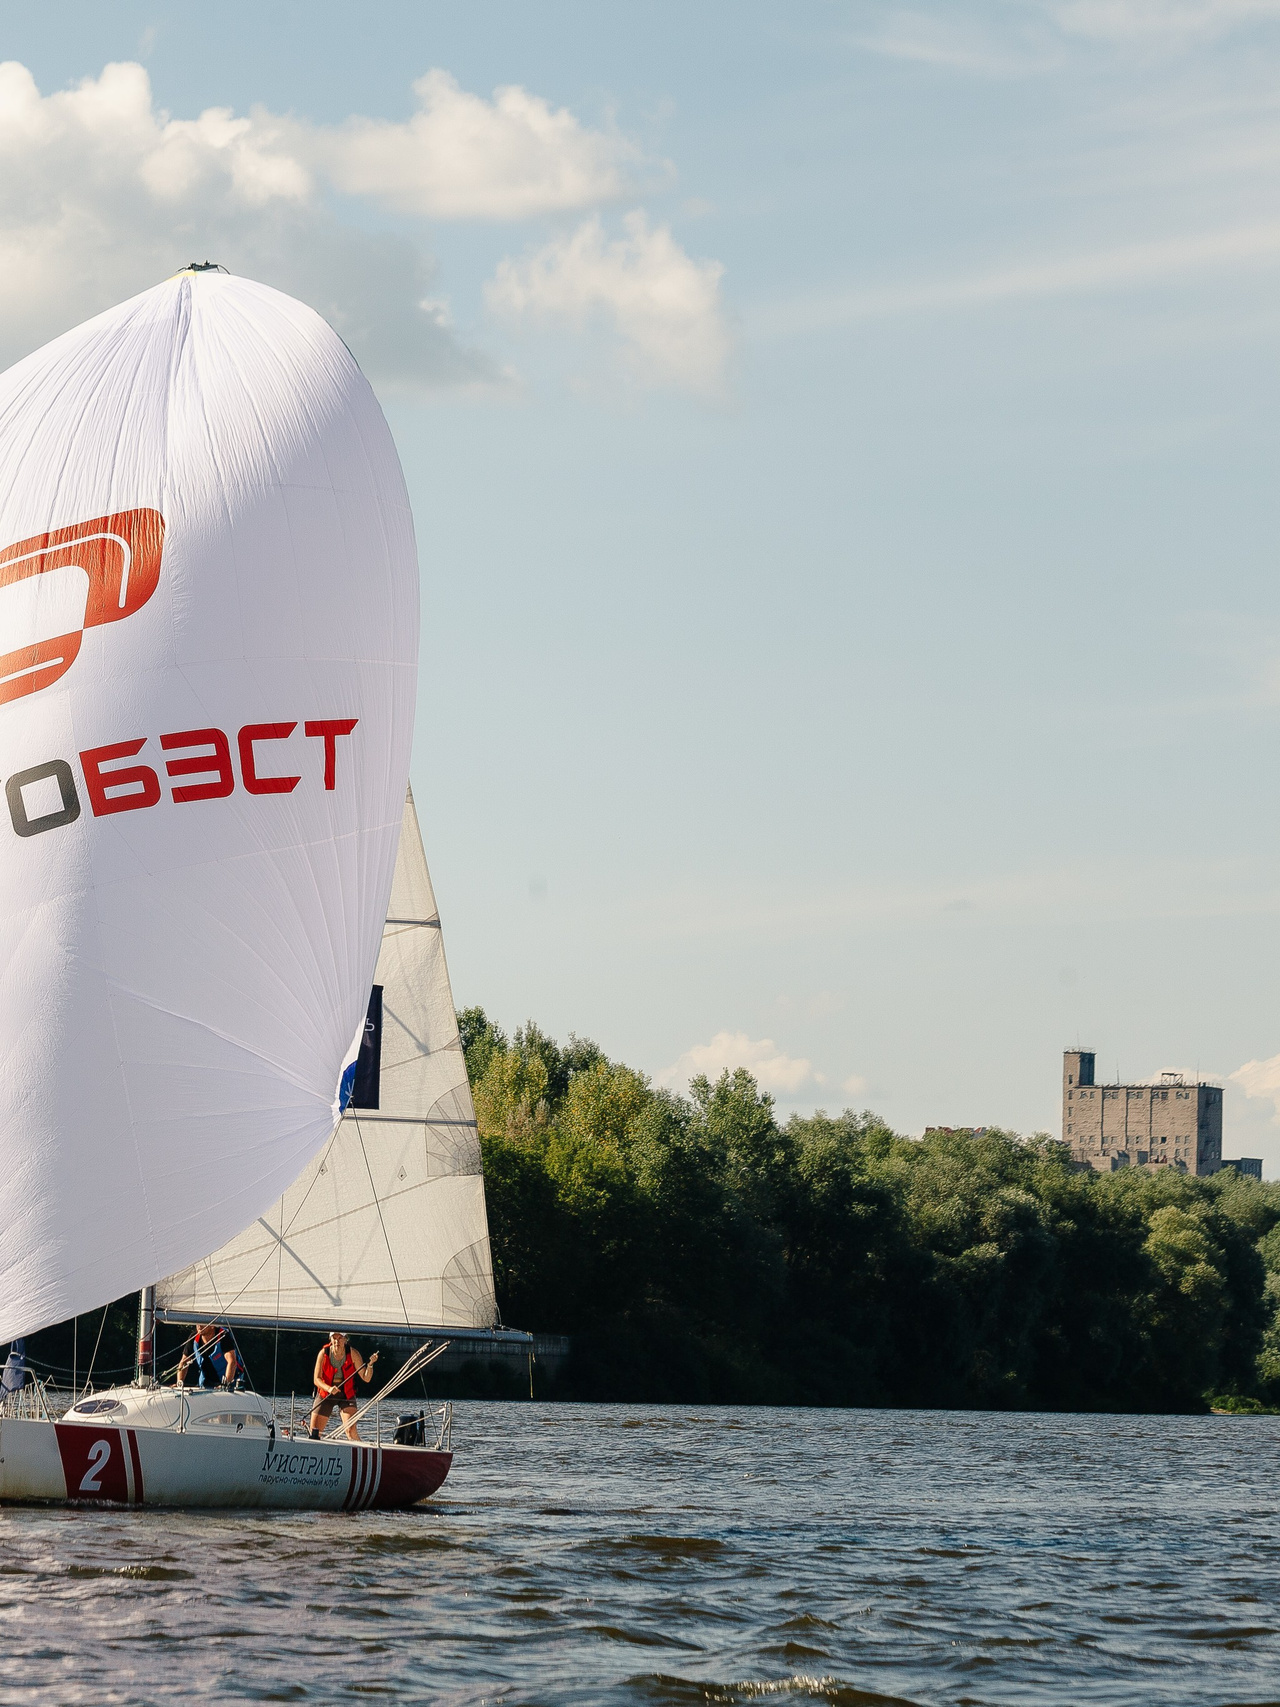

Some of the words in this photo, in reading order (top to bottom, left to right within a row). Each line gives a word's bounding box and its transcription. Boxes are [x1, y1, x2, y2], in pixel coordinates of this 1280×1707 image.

[79, 1440, 111, 1491] 2
[262, 1453, 343, 1476] МИСТРАЛЬ
[323, 1476, 340, 1488] клуб
